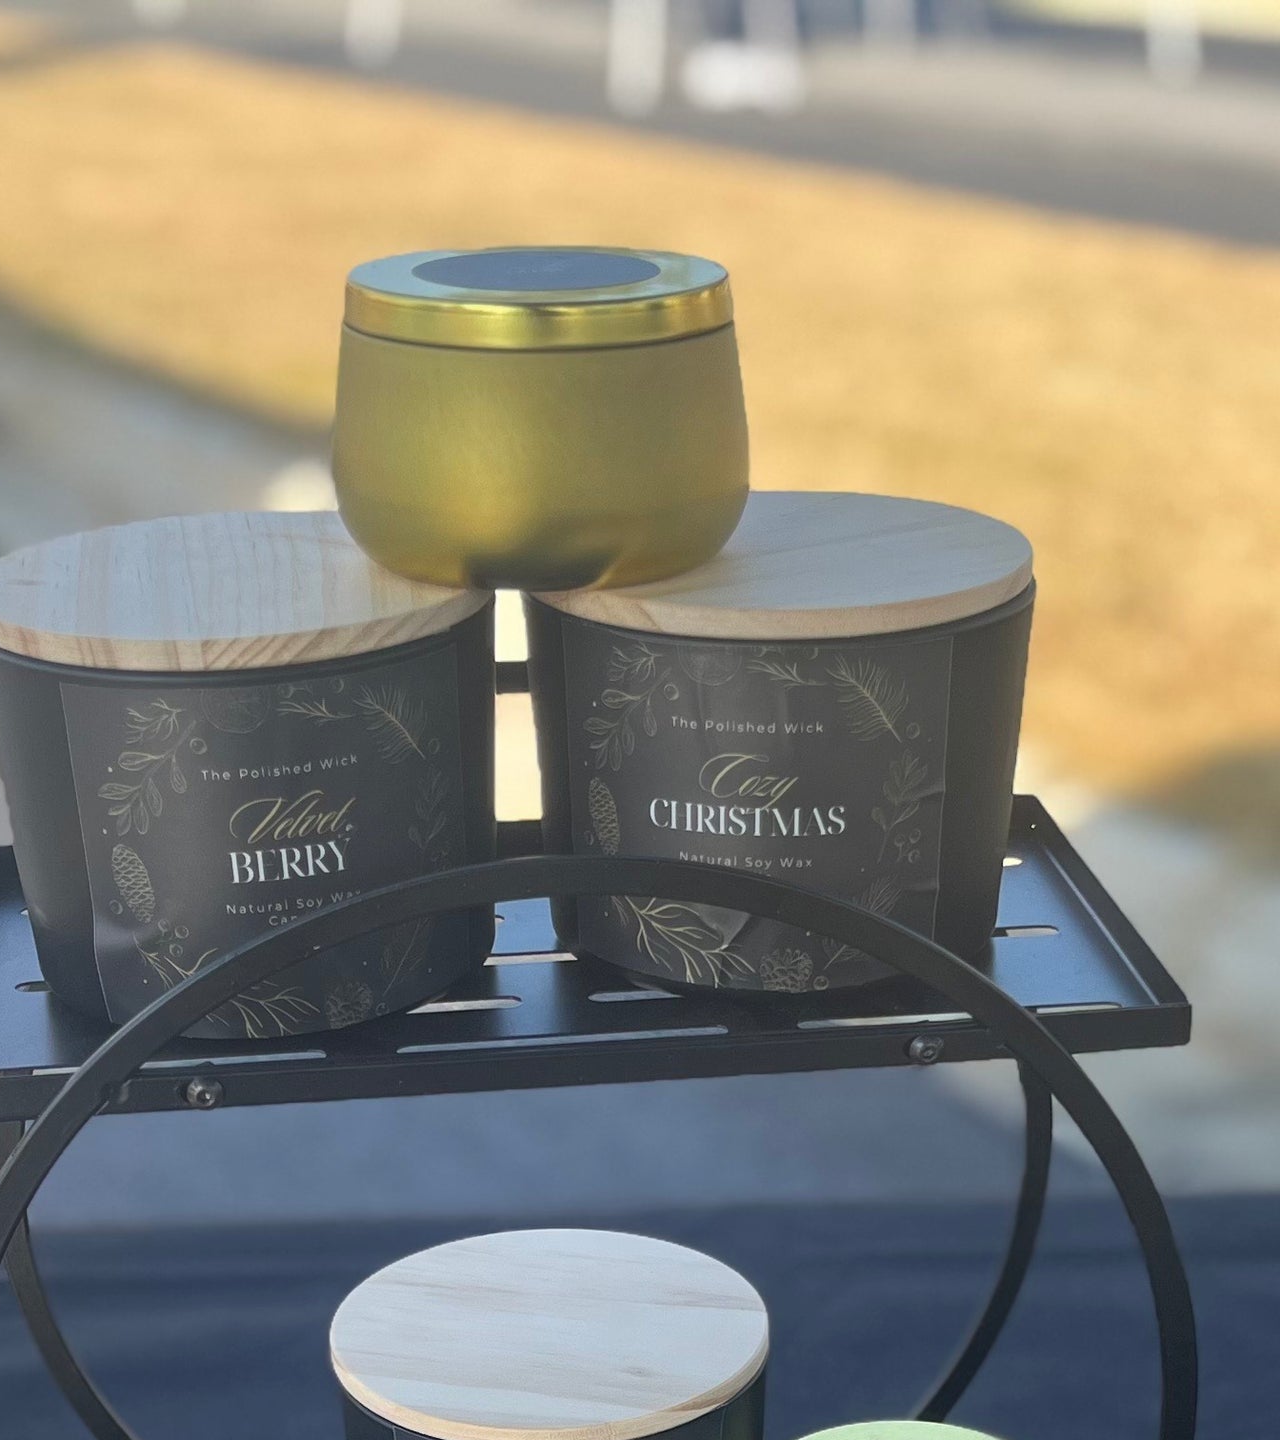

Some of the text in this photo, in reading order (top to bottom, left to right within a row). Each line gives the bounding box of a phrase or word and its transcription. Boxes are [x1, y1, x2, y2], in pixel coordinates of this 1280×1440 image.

[671, 715, 824, 734] The Polished Wick
[201, 753, 358, 782] The Polished Wick
[698, 752, 800, 812] Cozy
[229, 789, 356, 844] Velvet
[649, 797, 847, 838] CHRISTMAS
[228, 837, 352, 886] BERRY
[745, 856, 773, 870] Soy
[780, 857, 813, 869] Wax
[226, 899, 288, 916] Natural
[296, 897, 323, 910] Soy
